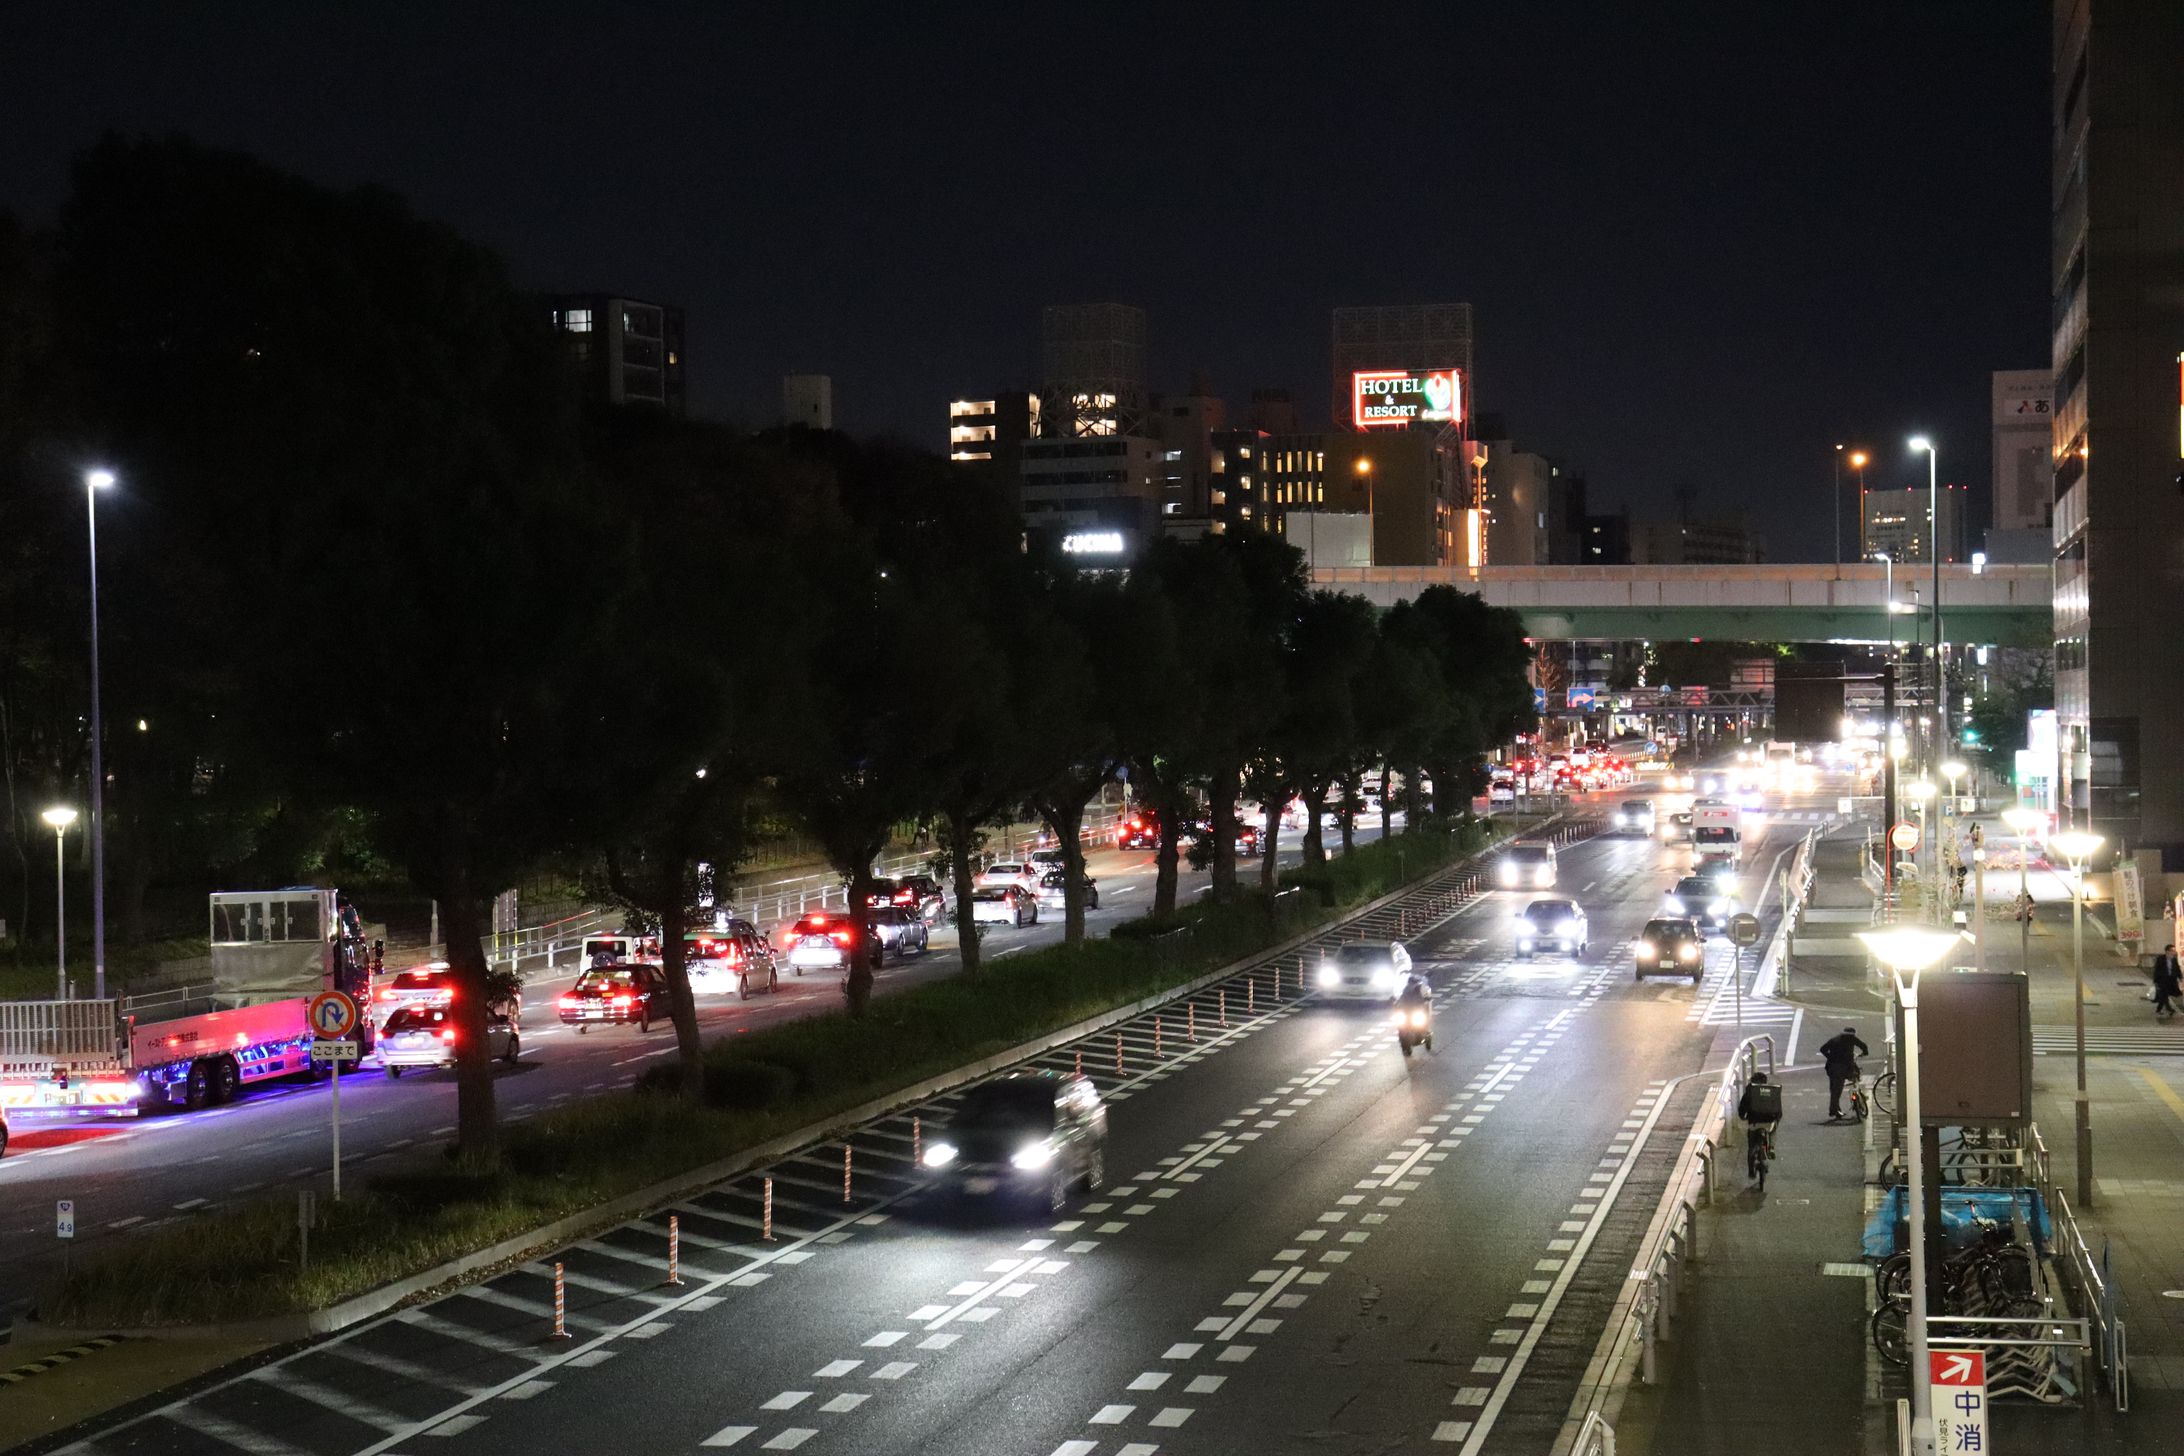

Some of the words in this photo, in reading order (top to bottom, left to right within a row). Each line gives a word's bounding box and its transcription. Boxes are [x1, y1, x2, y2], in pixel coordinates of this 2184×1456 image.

[1360, 378, 1423, 395] HOTEL
[1385, 394, 1395, 405] &
[1364, 405, 1418, 418] RESORT
[313, 1045, 355, 1056] ここまで
[1939, 1418, 1949, 1456] 伏見ライ
